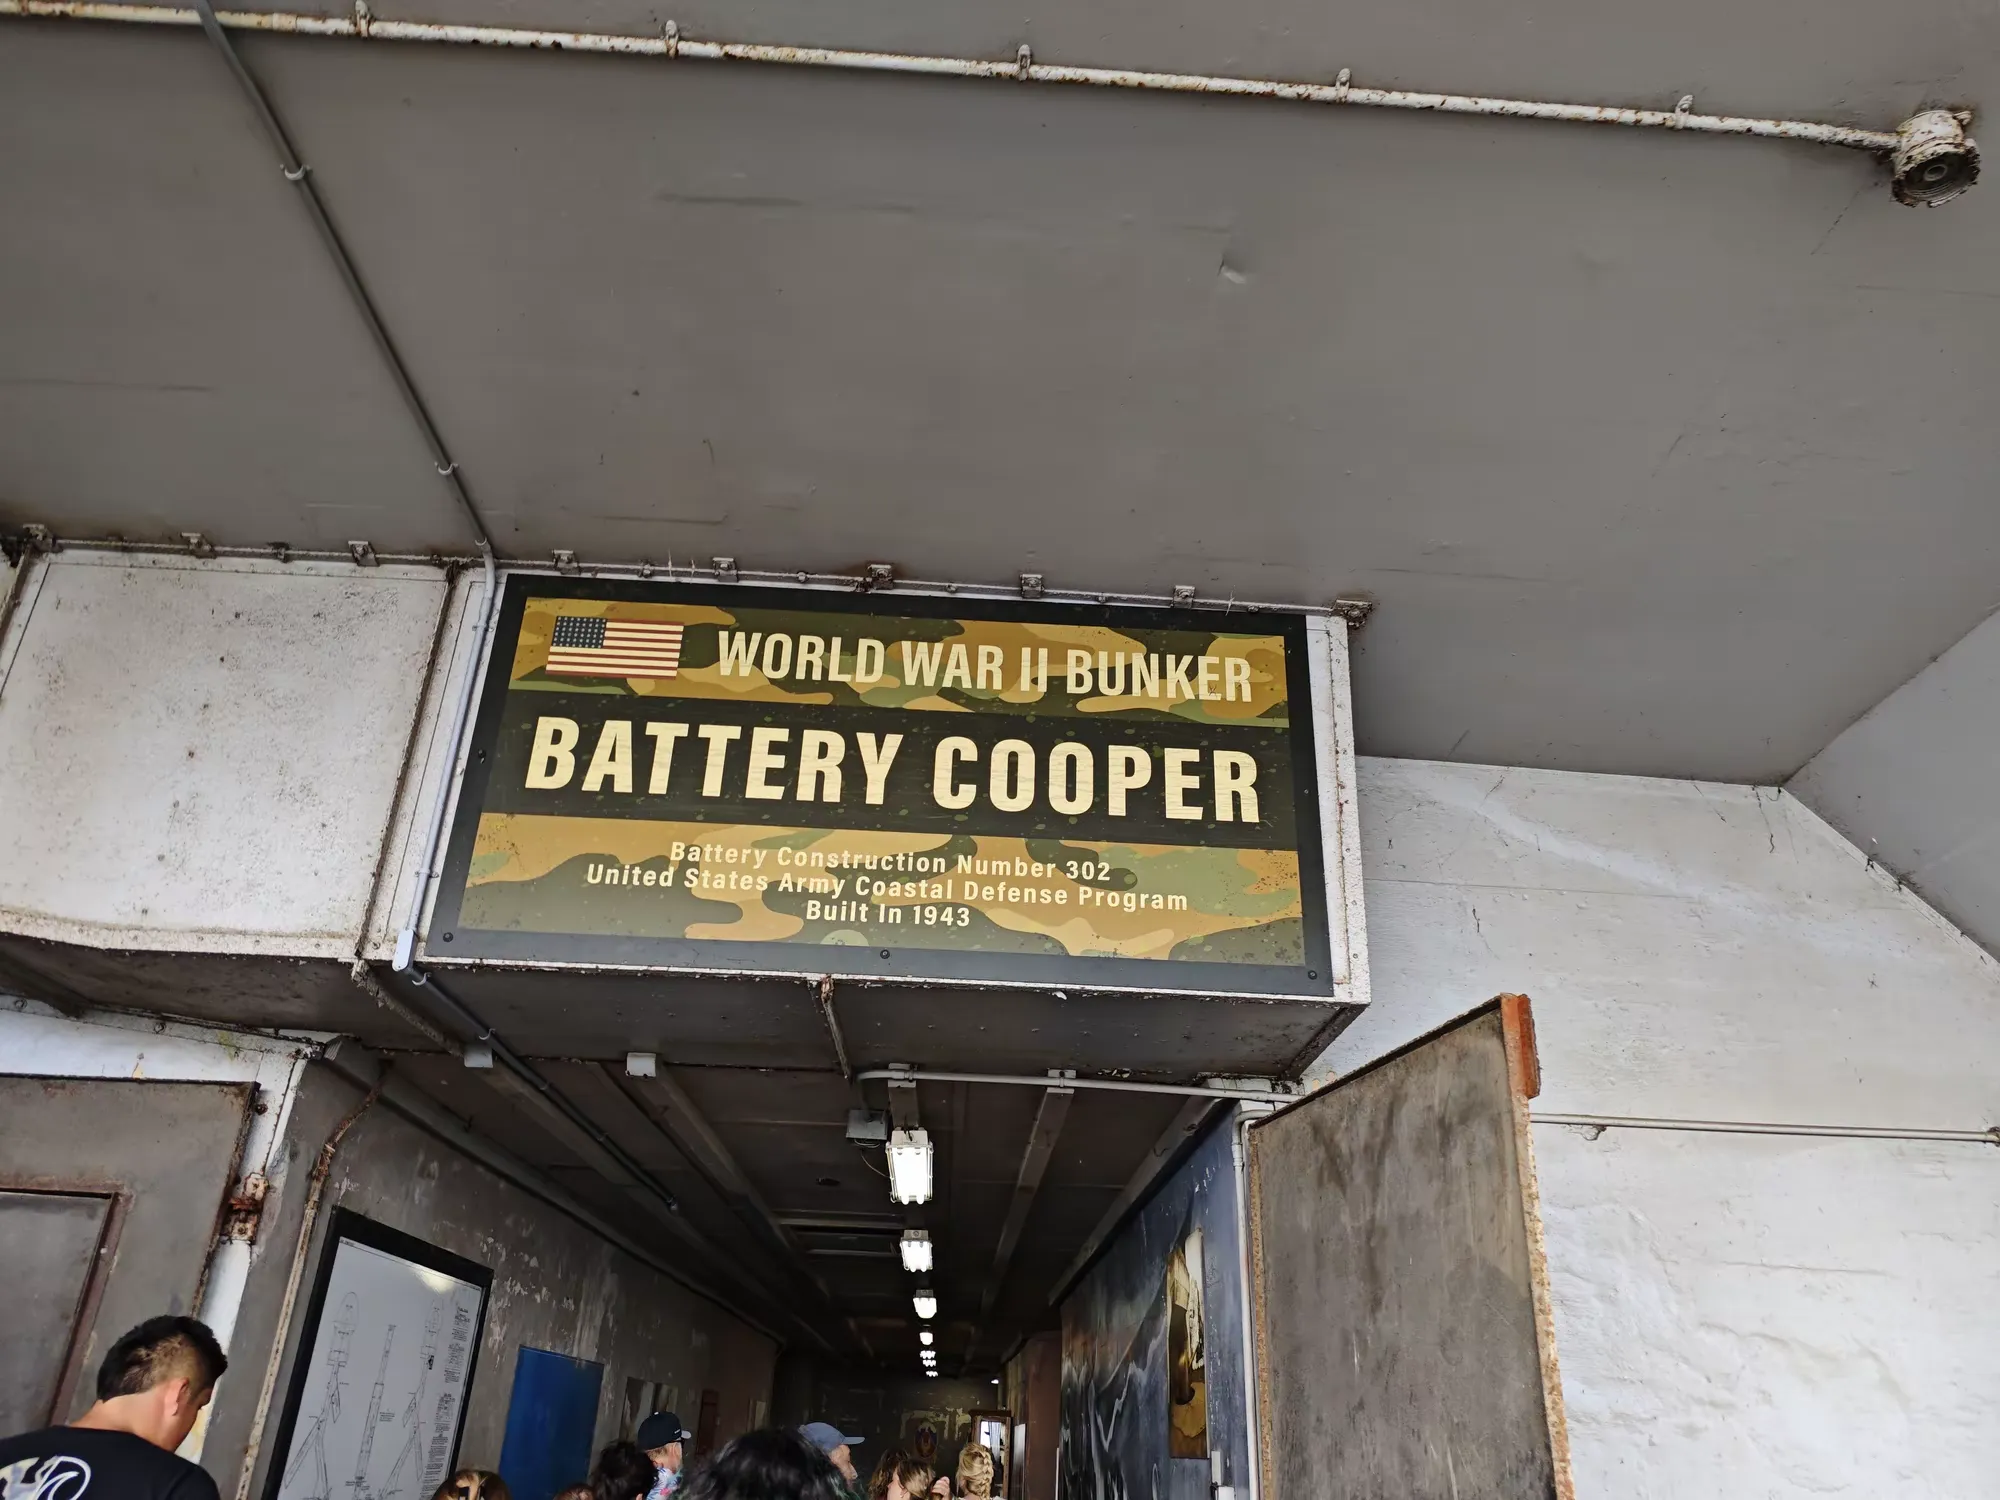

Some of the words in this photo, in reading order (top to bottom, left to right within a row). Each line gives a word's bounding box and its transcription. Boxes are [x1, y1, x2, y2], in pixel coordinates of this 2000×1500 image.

[718, 631, 884, 683] WORLD
[901, 640, 1003, 691] WAR
[1020, 647, 1048, 693] II
[1066, 649, 1252, 702] BUNKER
[525, 716, 903, 805] BATTERY
[933, 736, 1260, 823] COOPER
[670, 841, 767, 869] Battery
[777, 847, 946, 873] Construction
[957, 855, 1056, 879] Number
[1066, 861, 1111, 881] 302
[587, 863, 674, 887] United
[684, 868, 768, 891] States
[778, 873, 845, 899] Army
[855, 876, 953, 900] Coastal
[964, 881, 1068, 904] Defense
[1079, 886, 1188, 912] Program
[806, 900, 868, 923] Built
[879, 904, 902, 924] In
[913, 905, 970, 927] 1943
